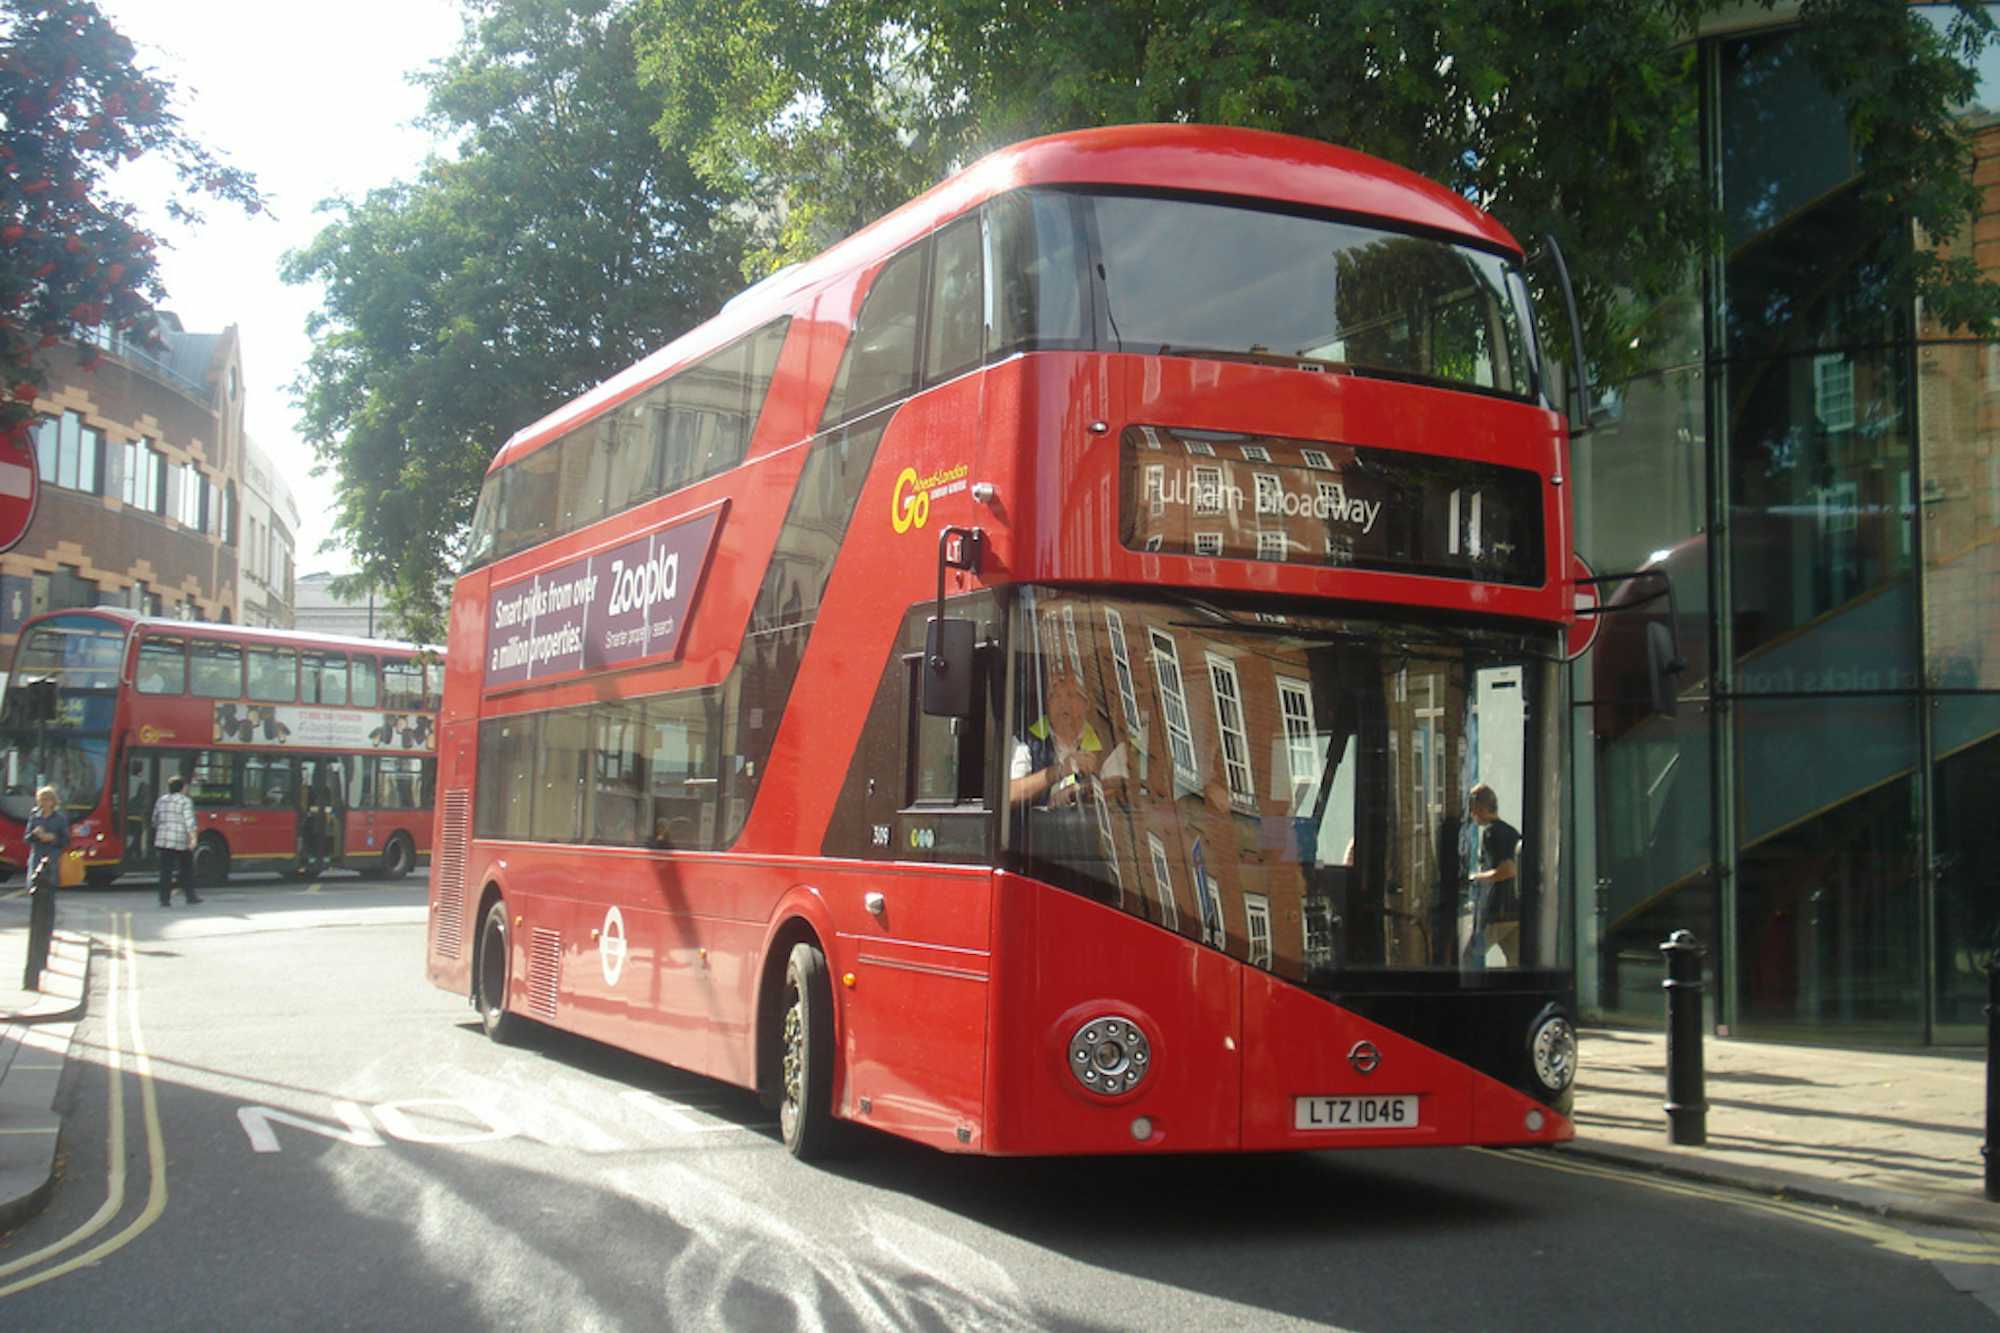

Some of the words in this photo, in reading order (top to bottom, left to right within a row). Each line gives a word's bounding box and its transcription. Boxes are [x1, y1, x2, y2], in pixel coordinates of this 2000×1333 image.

[892, 467, 929, 534] Go
[1144, 467, 1243, 512] Fulham
[1255, 480, 1381, 534] Broadway
[1449, 488, 1483, 557] 11
[495, 594, 522, 630] Smart
[522, 584, 547, 629] picks
[547, 580, 573, 614] from
[574, 576, 599, 606] over
[608, 543, 678, 619] Zoopla
[498, 635, 529, 670] million
[1310, 1100, 1352, 1124] LTZ
[1358, 1099, 1405, 1123] 1046
